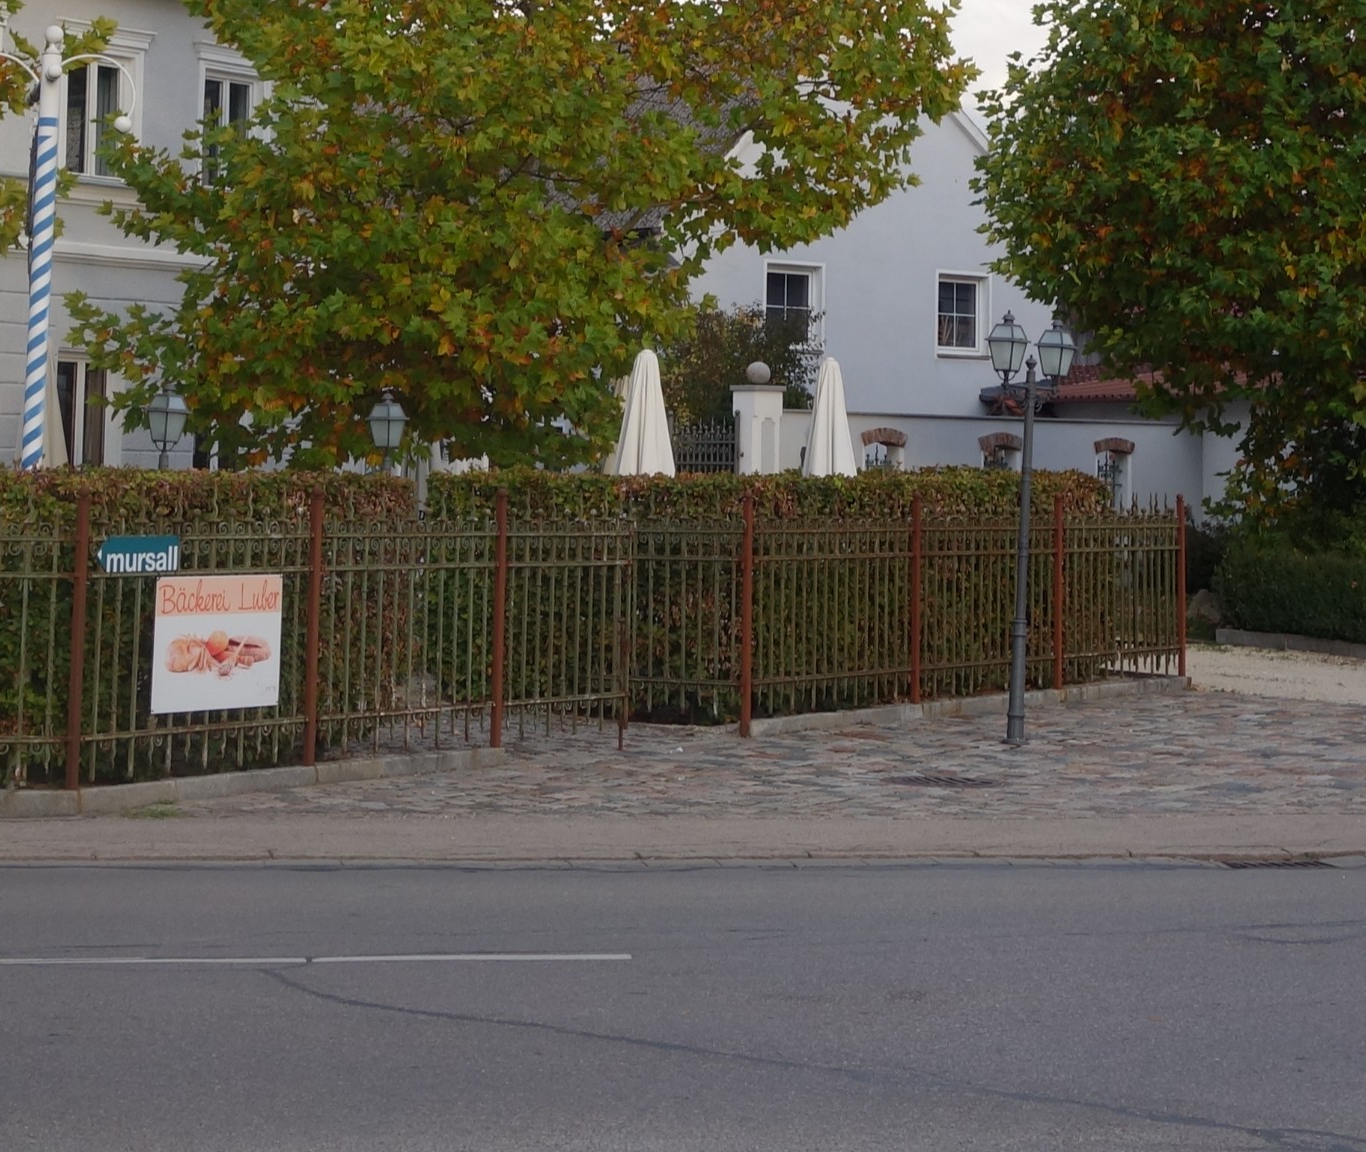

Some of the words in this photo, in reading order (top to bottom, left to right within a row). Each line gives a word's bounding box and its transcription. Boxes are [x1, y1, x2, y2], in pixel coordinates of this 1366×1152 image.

[106, 546, 178, 572] mursall
[159, 579, 230, 614] Bäckerei
[238, 579, 279, 611] Luber
